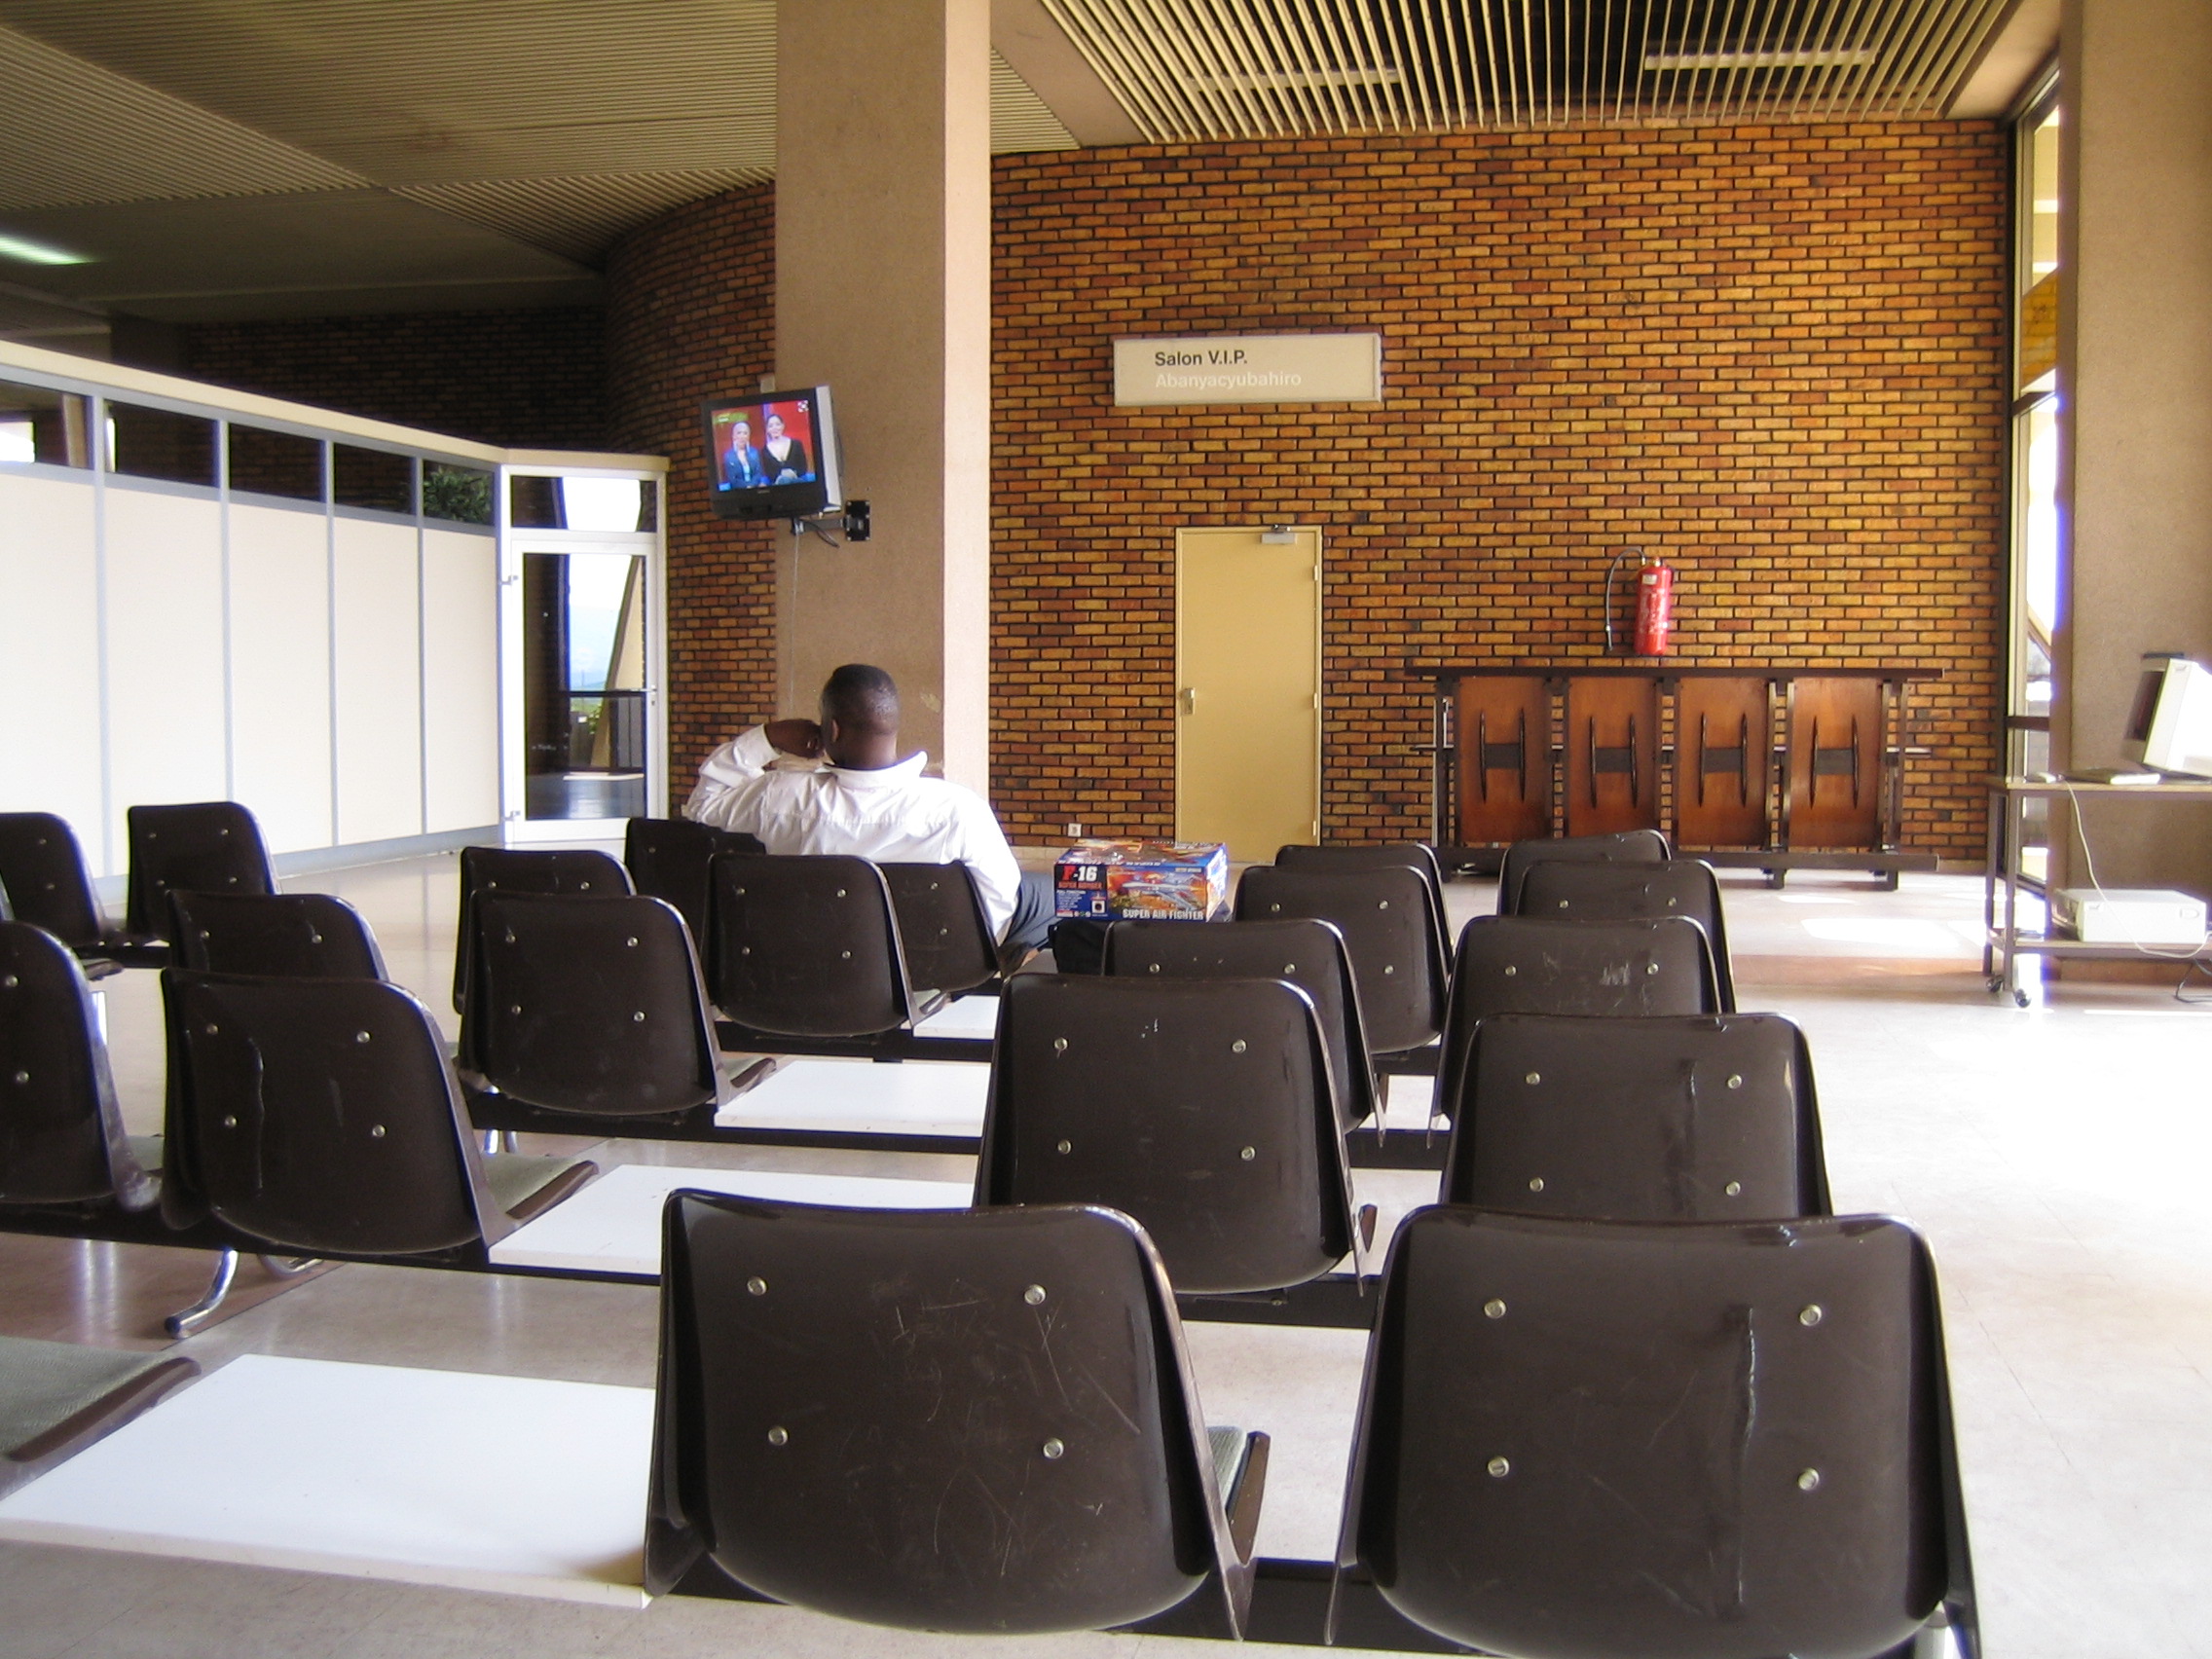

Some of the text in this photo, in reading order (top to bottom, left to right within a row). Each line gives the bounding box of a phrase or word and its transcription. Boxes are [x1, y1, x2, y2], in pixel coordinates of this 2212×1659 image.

[1155, 350, 1247, 366] Salon V.I.P.
[1155, 371, 1302, 389] Abanyacyubahiro
[1062, 866, 1098, 882] F-16
[1123, 908, 1203, 921] SUPER AIR FIGHTER
